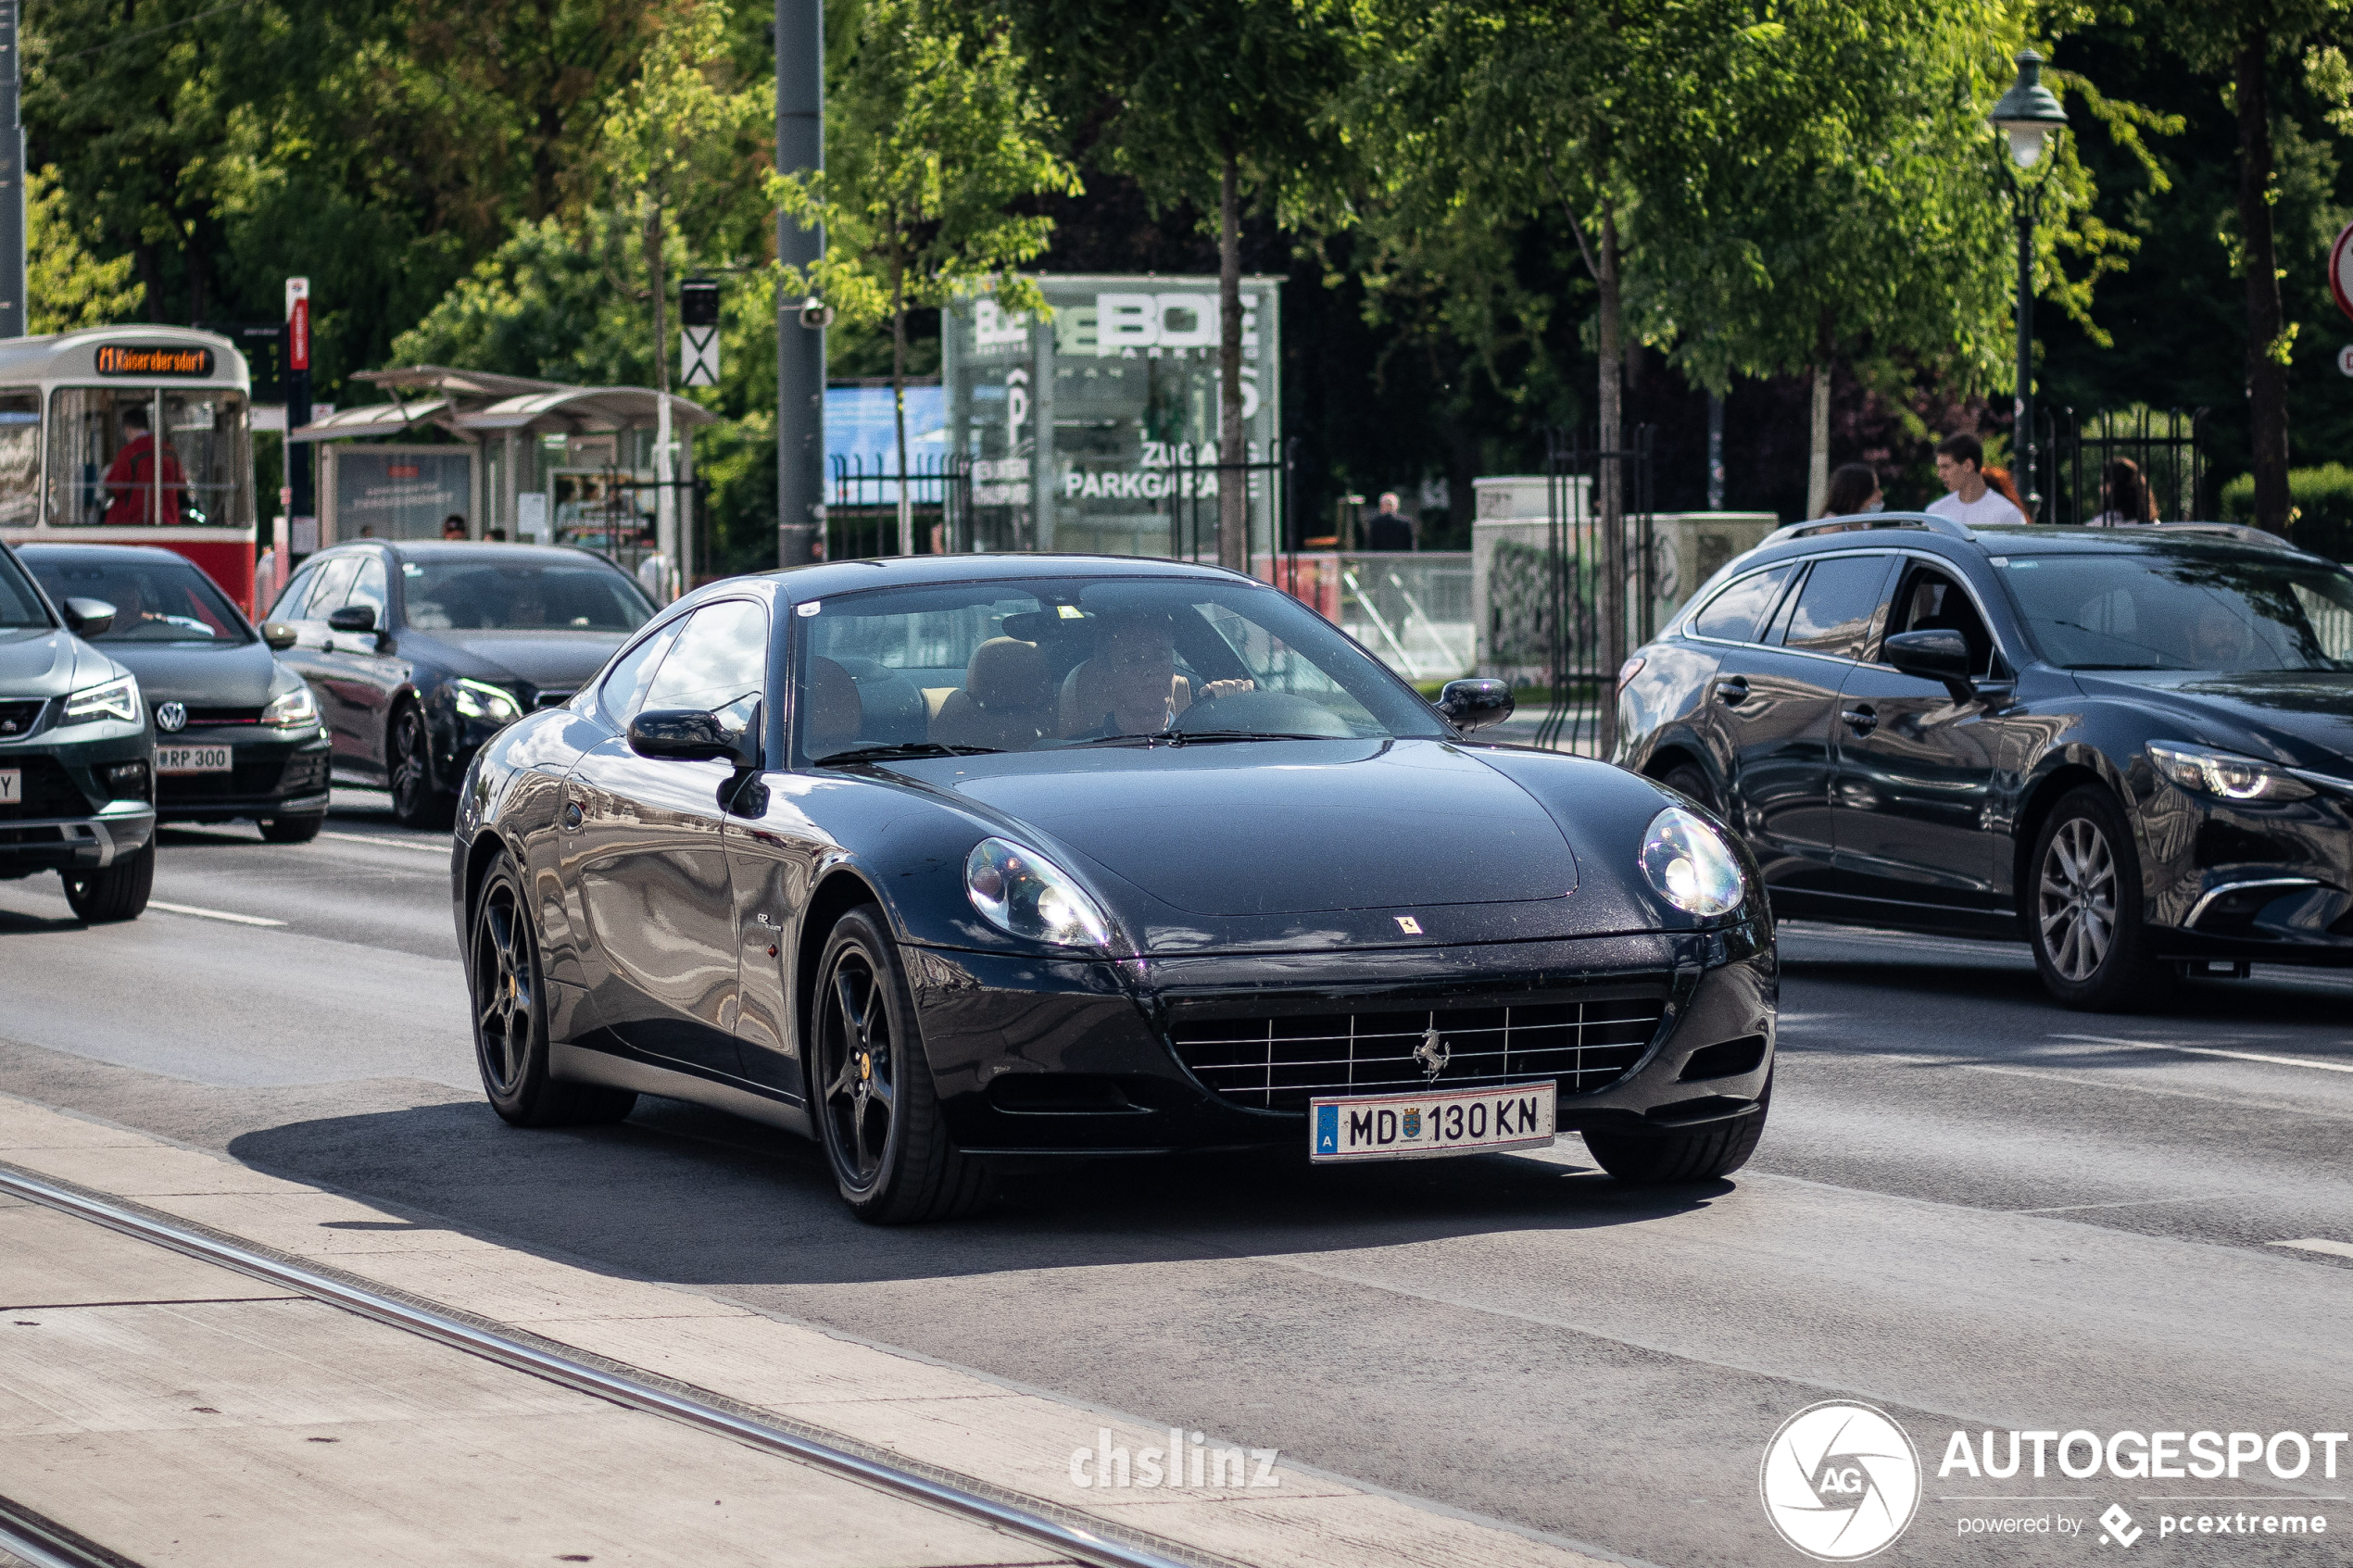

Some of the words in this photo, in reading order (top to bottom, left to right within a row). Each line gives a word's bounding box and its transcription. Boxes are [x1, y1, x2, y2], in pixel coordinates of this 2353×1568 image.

[195, 749, 226, 768] 300
[1322, 1135, 1333, 1148] A
[1350, 1110, 1397, 1148] MD
